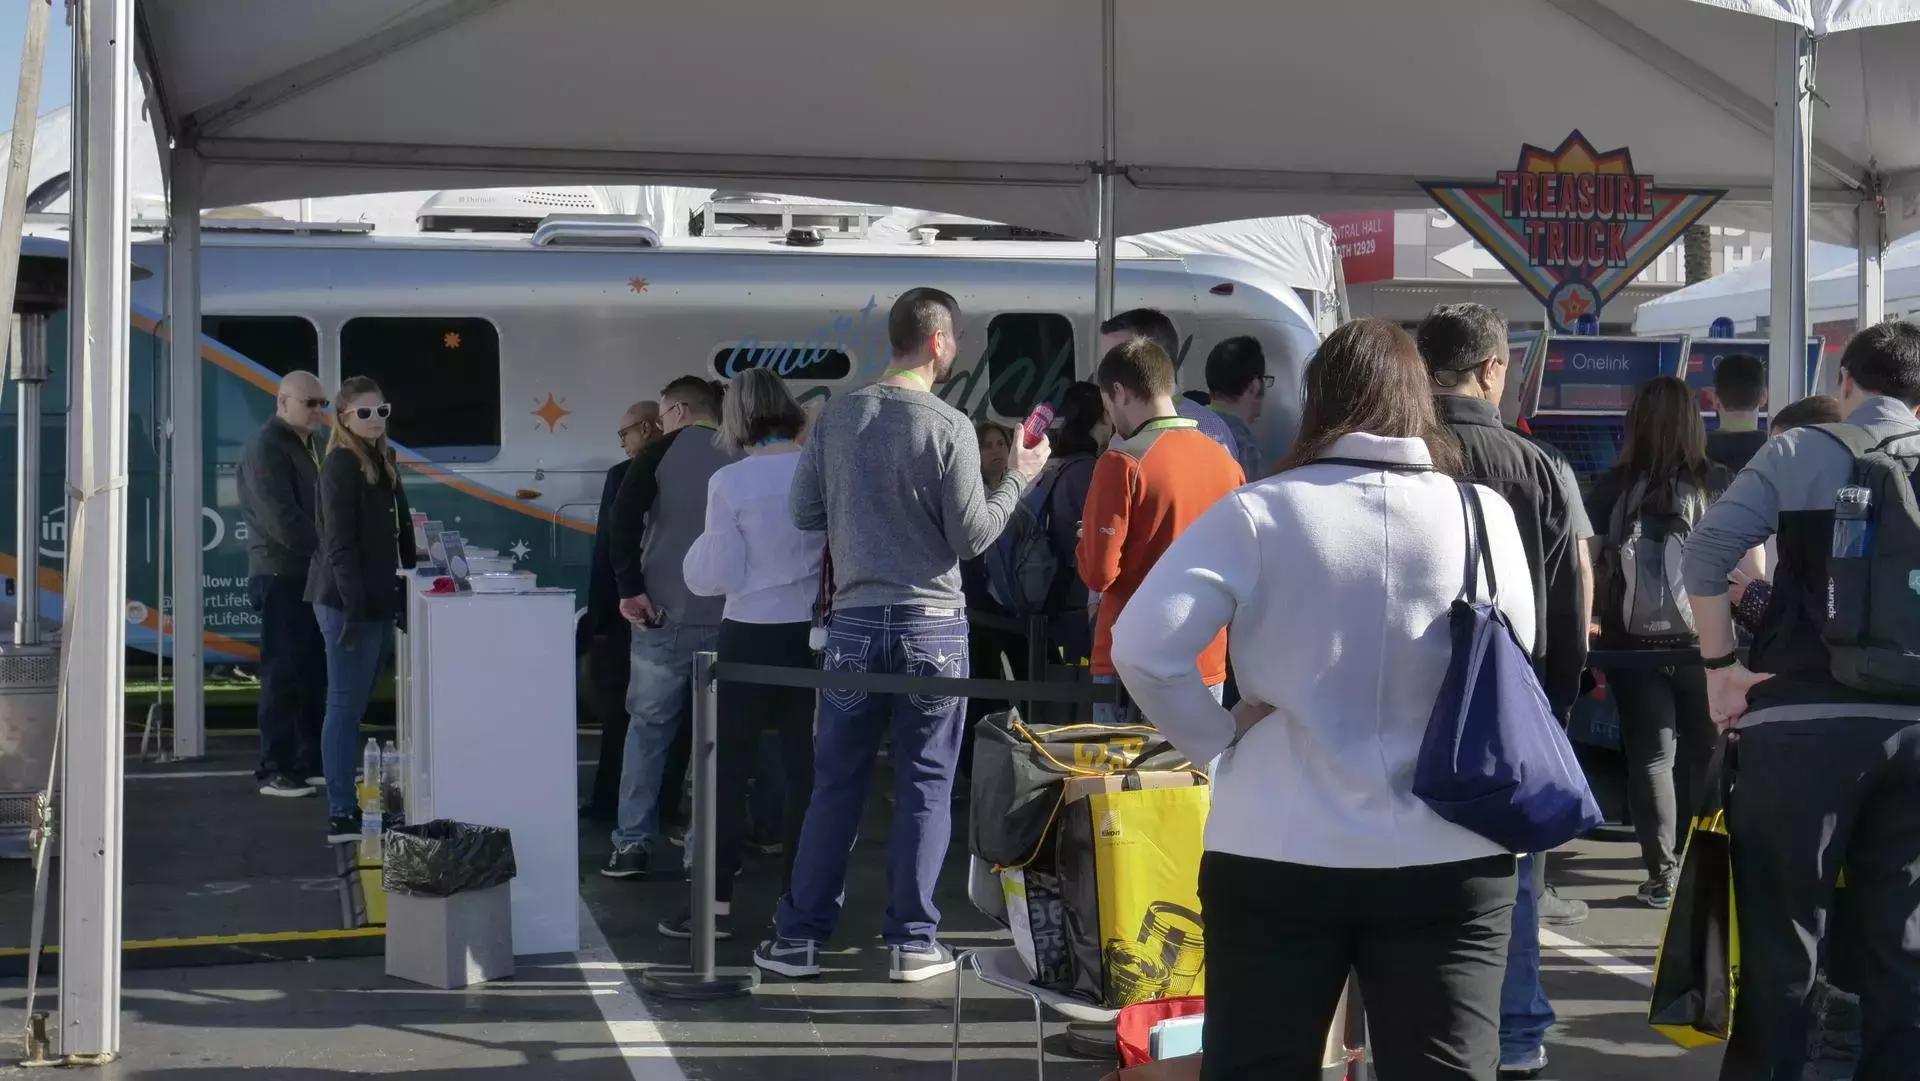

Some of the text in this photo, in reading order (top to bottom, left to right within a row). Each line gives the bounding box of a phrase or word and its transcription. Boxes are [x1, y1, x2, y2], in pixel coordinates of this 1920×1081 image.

[1498, 172, 1654, 220] TREASURE
[1333, 218, 1383, 239] NTRAL HALL
[1336, 240, 1376, 258] OTH 12929
[1526, 220, 1627, 267] TRUCK
[1572, 353, 1630, 370] Onelink
[202, 575, 232, 588] llow
